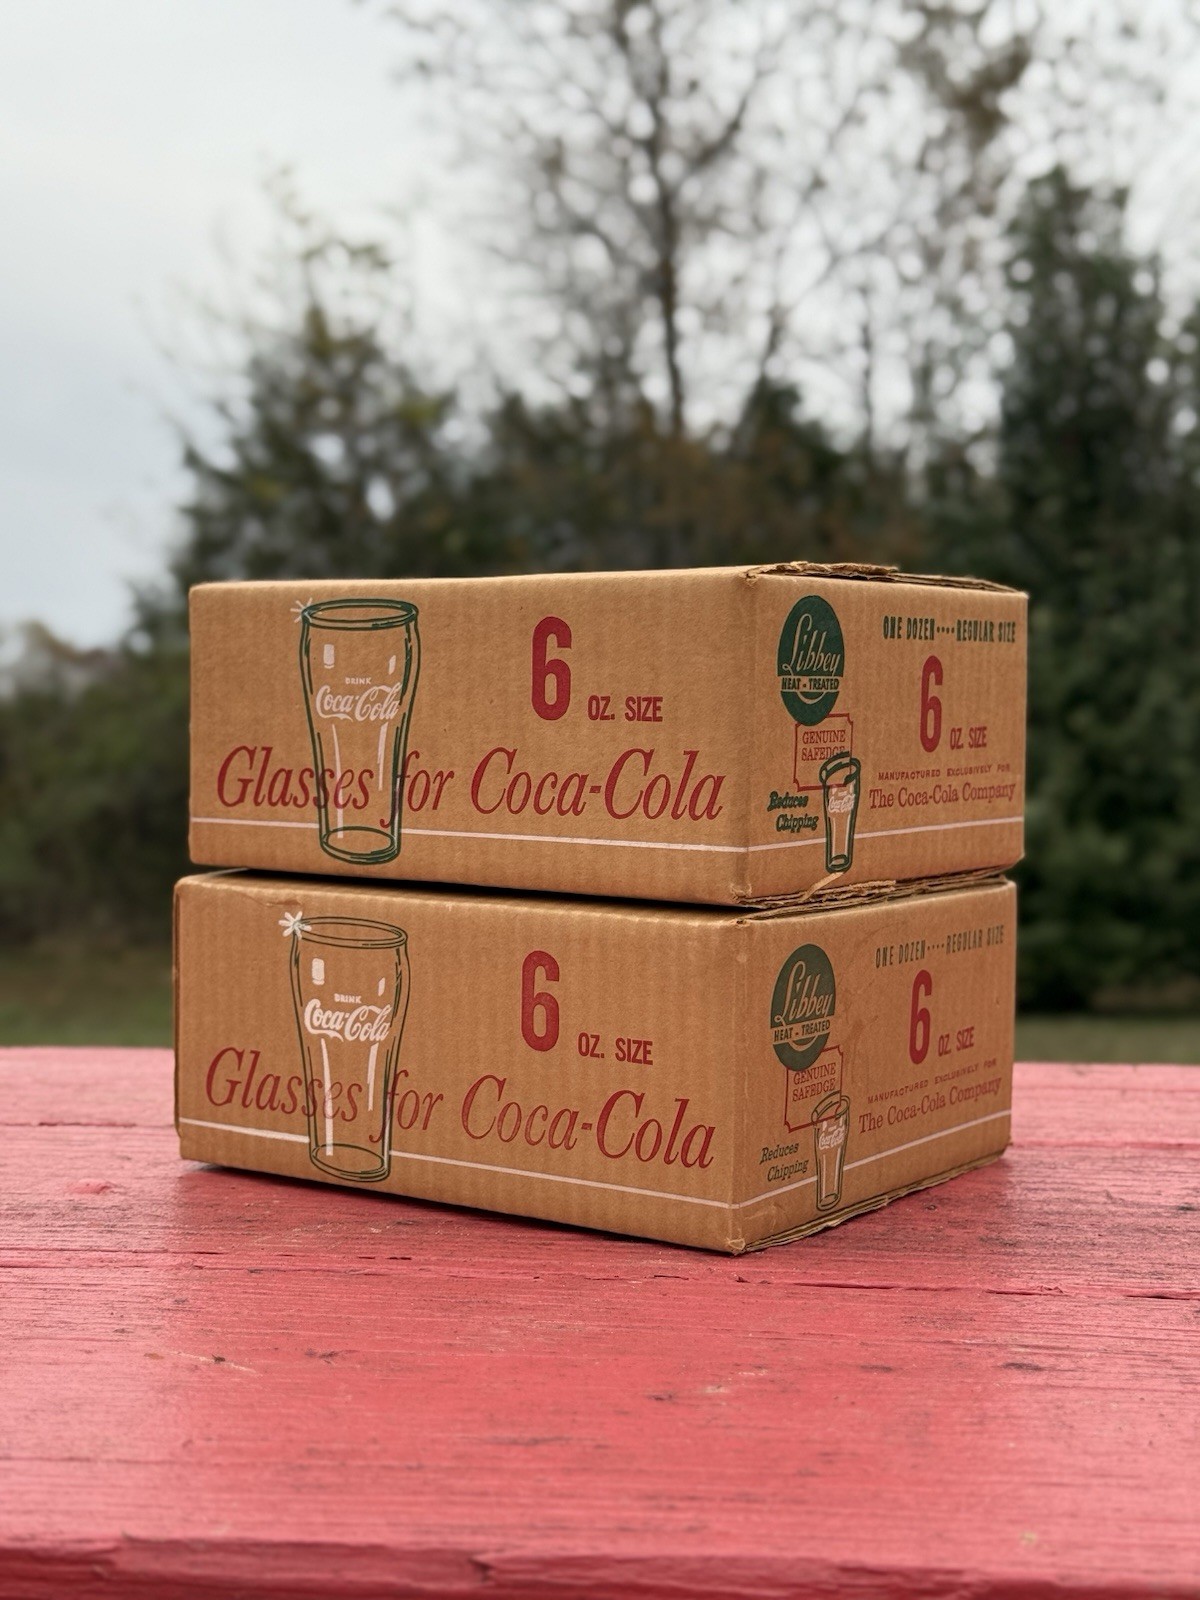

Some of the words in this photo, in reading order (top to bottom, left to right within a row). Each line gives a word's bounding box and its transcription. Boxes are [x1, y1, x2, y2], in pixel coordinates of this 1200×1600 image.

[782, 613, 841, 677] Libbey
[883, 616, 902, 639] ONE
[998, 621, 1016, 643] SIZE
[345, 677, 372, 685] DRINK
[531, 616, 572, 721] 6
[588, 695, 615, 721] OZ.
[624, 696, 663, 722] SIZE
[919, 655, 944, 753] 6
[969, 726, 988, 748] SIZE
[802, 729, 846, 744] GENUINE
[217, 746, 374, 810] Glasses
[379, 750, 455, 828] for
[471, 747, 726, 821] Coca-Cola
[878, 769, 941, 781] MANUFACTURED
[947, 765, 993, 778] EXCLUSIVELY
[997, 763, 1011, 773] FOR
[869, 788, 894, 809] The
[898, 784, 959, 807] Coca-Cola
[962, 782, 1016, 803] Company
[776, 813, 819, 833] Chipping
[875, 946, 894, 969] ONE
[987, 925, 1004, 946] SIZE
[334, 993, 362, 1004] DRINK
[521, 950, 560, 1052] 6
[578, 1032, 605, 1059] OZ.
[615, 1038, 653, 1065] SIZE
[774, 961, 833, 1027] Libbey
[909, 969, 932, 1065] 6
[956, 1026, 975, 1051] SIZE
[792, 1078, 836, 1102] SAFEDGE
[793, 1062, 836, 1086] GENUINE
[867, 1080, 929, 1104] MANUFACTURED
[934, 1062, 979, 1084] EXCLUSIVELY
[983, 1058, 997, 1068] FOR
[205, 1047, 362, 1122] Glasses
[369, 1069, 444, 1143] for
[461, 1075, 716, 1169] Coca-Cola
[858, 1112, 884, 1134] The
[887, 1092, 946, 1125] Coca-Cola
[950, 1077, 1002, 1104] Company
[760, 1142, 799, 1165] Reduces
[767, 1160, 809, 1182] Chipping
